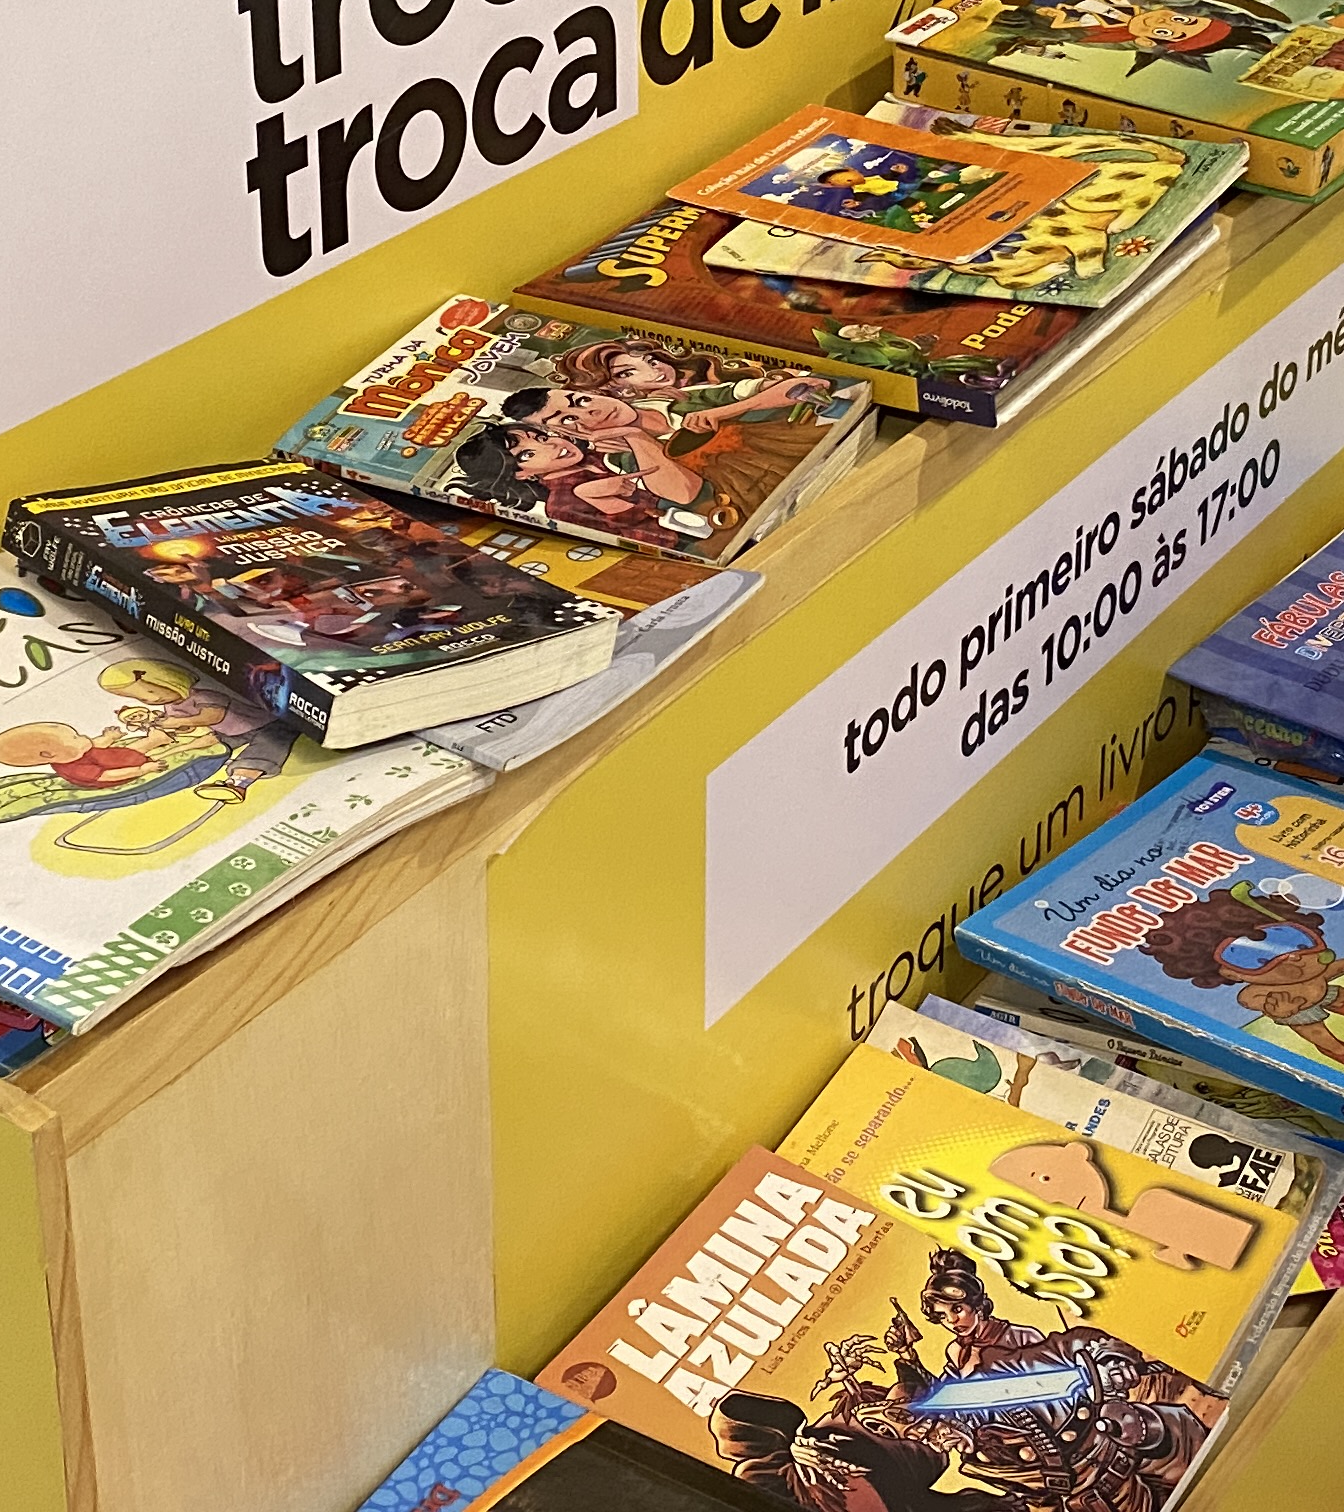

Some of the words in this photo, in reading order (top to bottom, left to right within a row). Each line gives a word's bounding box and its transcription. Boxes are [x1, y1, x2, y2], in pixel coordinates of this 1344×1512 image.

[246, 4, 618, 279] troca
[596, 204, 706, 290] SUPERM
[961, 302, 1035, 351] Pode
[361, 350, 406, 385] TURMA
[403, 338, 427, 359] DA
[456, 331, 532, 387] JOVEM
[921, 390, 974, 414] Todolivro
[71, 488, 135, 507] AVENTURA
[137, 482, 167, 497] NÃO
[172, 476, 216, 491] OFICIAL
[235, 463, 301, 482] MINECRAFT
[139, 497, 238, 521] CRÔNICAS
[240, 491, 269, 506] DE
[92, 485, 358, 549] ELEMENTIA
[47, 535, 62, 572] WOLFE
[216, 529, 325, 557] MISSÃO
[233, 536, 348, 567] JUSTIÇA
[844, 657, 946, 774] todo
[956, 508, 1120, 683] primeiro
[1129, 400, 1250, 529] sábado
[1258, 360, 1298, 422] do
[960, 671, 1030, 759] das
[1040, 563, 1144, 676] 10:00
[1152, 532, 1187, 592] às
[1196, 438, 1282, 546] 17:00
[145, 613, 186, 648] MISSÃO
[186, 639, 232, 677] JUSTIÇA
[371, 636, 419, 658] SEAN
[419, 628, 454, 646] FRY
[454, 613, 513, 637] WOLFE
[437, 633, 499, 653] ROCCO
[288, 690, 328, 724] ROCCO
[475, 710, 518, 734] FTD
[1017, 783, 1087, 870] um
[1098, 697, 1178, 796] livro
[1193, 787, 1235, 814] TOYSTER
[1267, 823, 1295, 845] Livro
[1292, 812, 1315, 830] com
[1286, 816, 1329, 850] historinha
[1043, 890, 1099, 924] Um
[1098, 864, 1137, 895] dia
[1138, 842, 1164, 868] no
[1060, 899, 1164, 965] FUNDO
[1126, 874, 1198, 918] DO
[1162, 840, 1256, 890] MAR
[988, 1008, 1018, 1025] AGIR
[1106, 1037, 1116, 1050] O
[1164, 1113, 1181, 1131] DE
[844, 1150, 861, 1168] se
[1238, 1147, 1284, 1195] FAE
[880, 1166, 967, 1222] eu
[605, 1171, 825, 1385] LÂMINA
[762, 1353, 784, 1376] Luis
[782, 1322, 810, 1355] Carlos
[861, 1220, 895, 1256] Dantas
[663, 1197, 878, 1419] AZULADA
